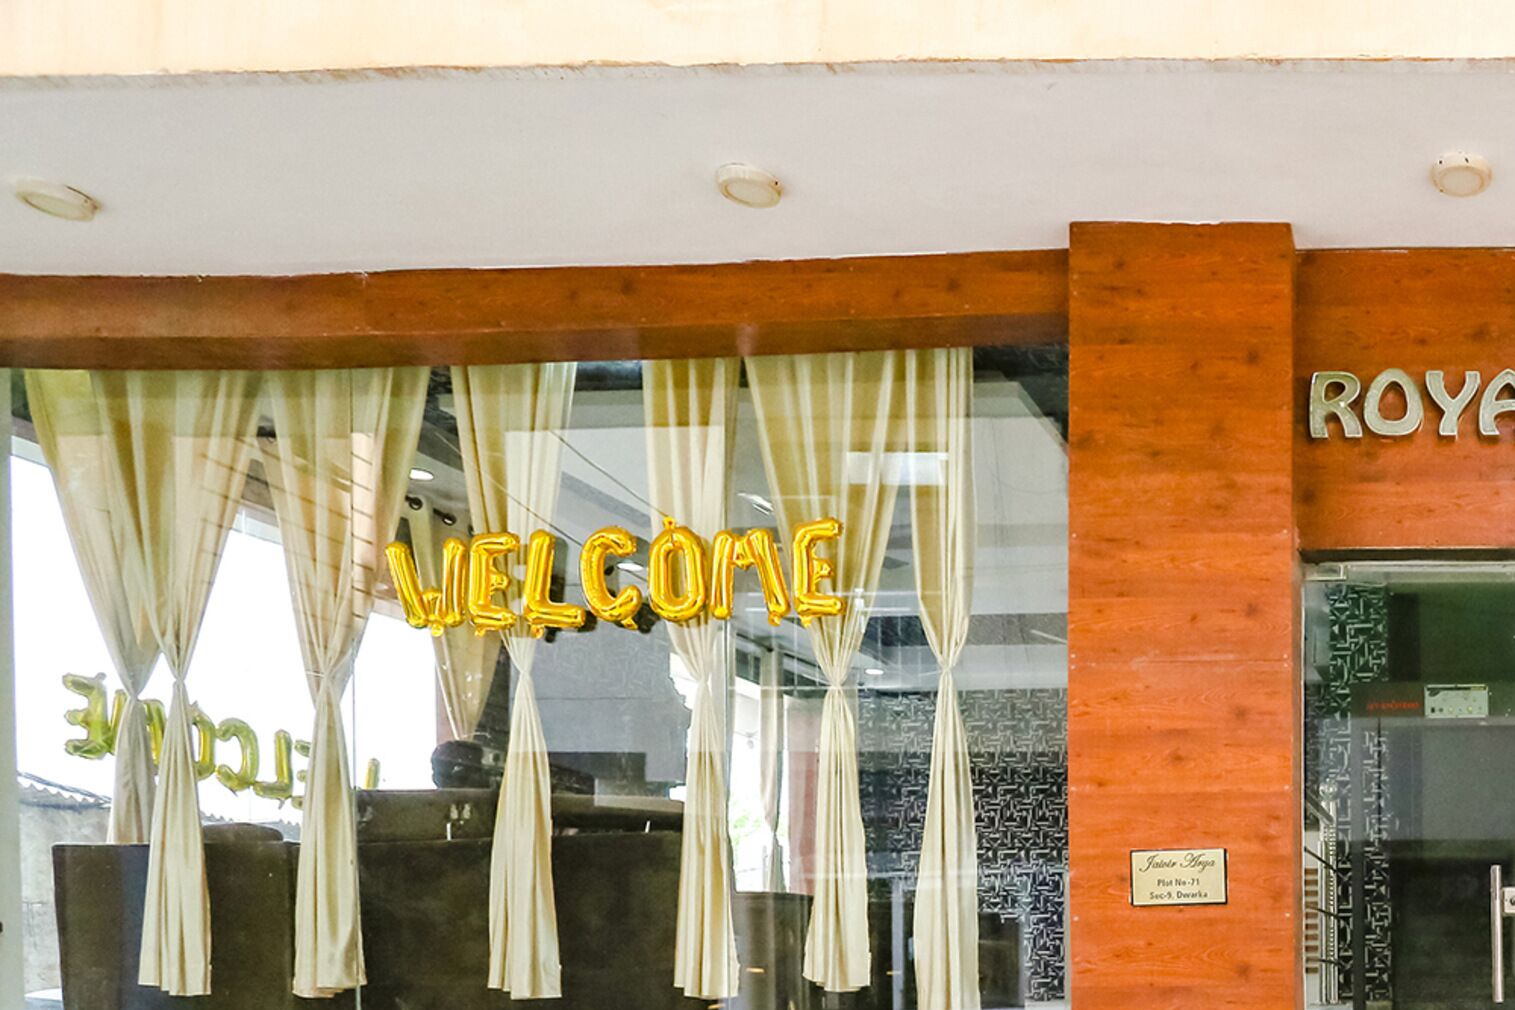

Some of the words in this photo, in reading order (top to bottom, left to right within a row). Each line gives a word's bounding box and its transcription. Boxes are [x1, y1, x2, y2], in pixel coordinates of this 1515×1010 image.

[384, 516, 846, 637] WELCOME
[1157, 879, 1174, 887] Plot
[1176, 889, 1208, 899] Dwarka
